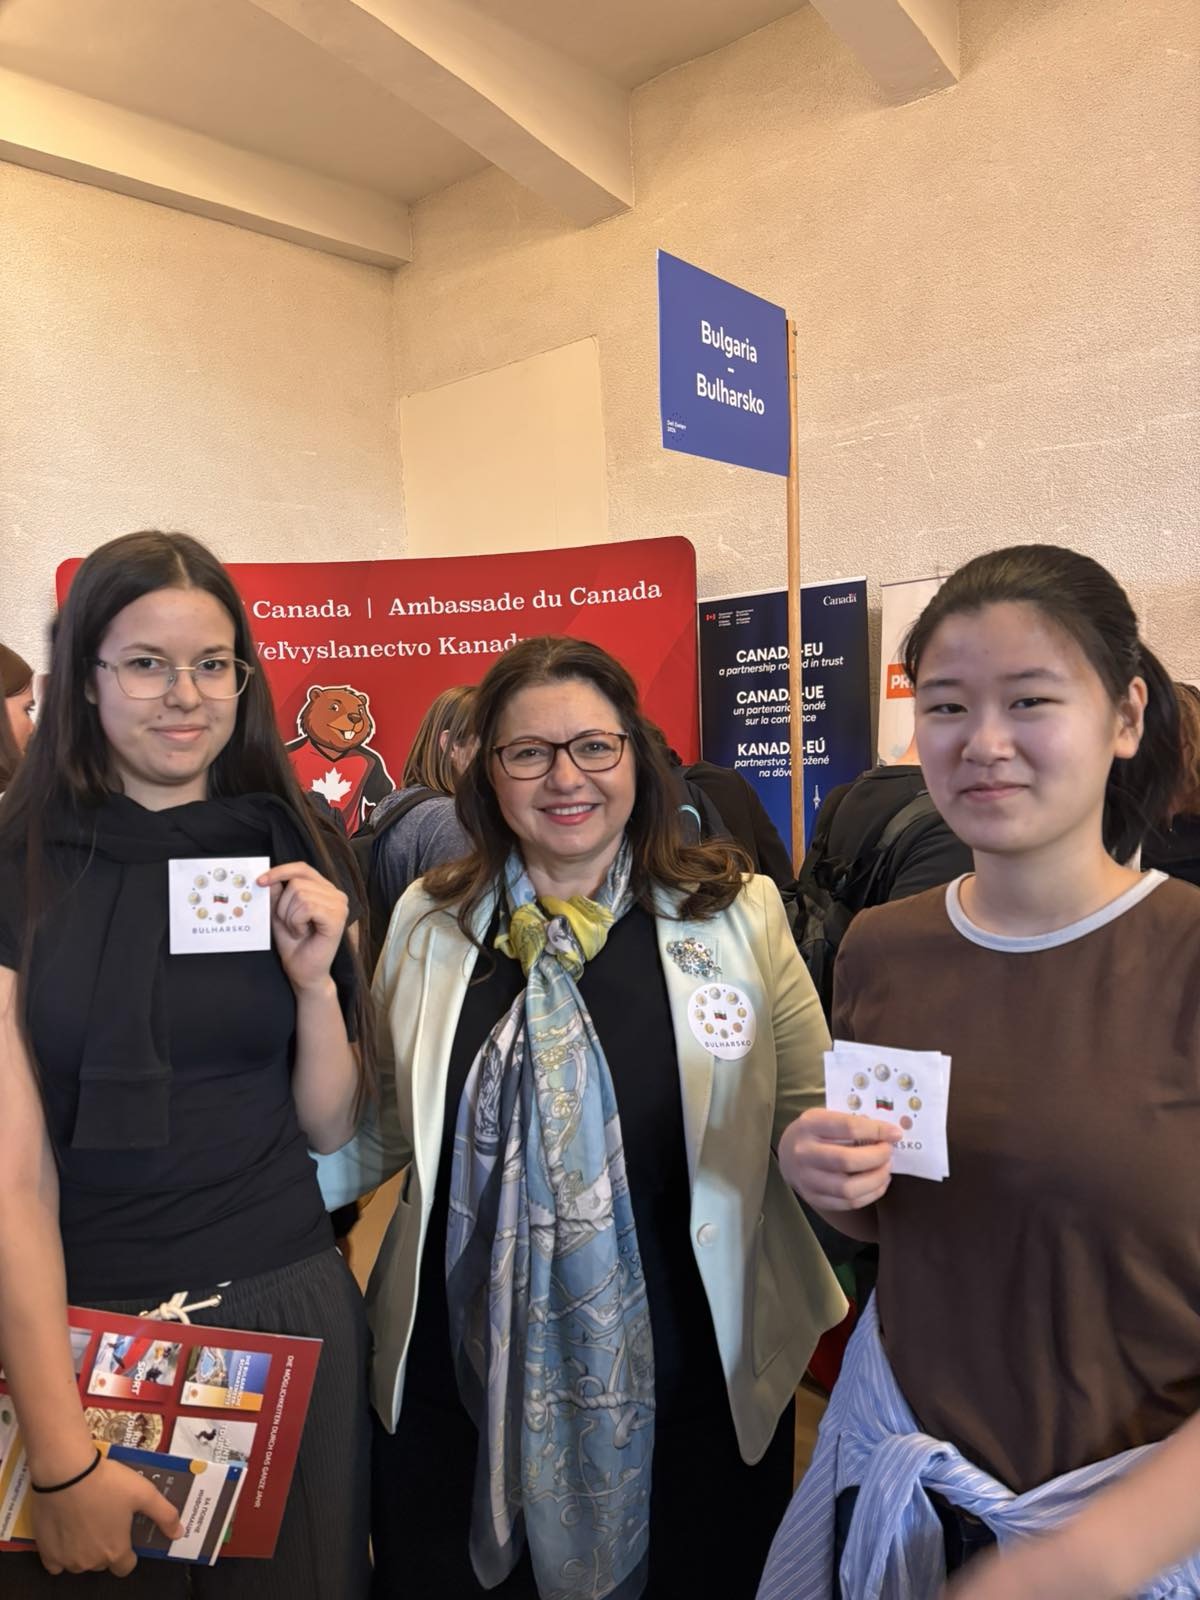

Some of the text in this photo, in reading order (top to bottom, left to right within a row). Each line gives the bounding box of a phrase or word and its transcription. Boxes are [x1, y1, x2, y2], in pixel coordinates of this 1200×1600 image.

[701, 320, 757, 363] Bulgaria
[697, 373, 765, 415] Bulharsko
[252, 600, 351, 619] Canada
[388, 592, 525, 616] Ambassade
[532, 590, 563, 609] du
[569, 580, 662, 606] Canada
[823, 593, 857, 606] Canada
[439, 633, 522, 655] Kanad
[736, 642, 823, 663] CANAD-EU
[718, 668, 725, 676] a
[726, 662, 776, 677] partnership
[810, 658, 819, 668] in
[821, 656, 844, 667] trust
[891, 674, 913, 690] PR
[736, 685, 824, 704] CANAD-UE
[733, 707, 745, 716] un
[801, 700, 827, 711] ondé
[745, 717, 758, 726] sur
[760, 716, 769, 725] la
[737, 737, 826, 756] KANAD-EÚ
[734, 758, 787, 769] partnerstvo
[759, 769, 770, 778] na
[192, 925, 250, 934] BULHARSKO
[705, 1040, 751, 1048] BULHARSKO
[131, 1361, 146, 1396] SPORT
[267, 1426, 279, 1450] DURCH
[264, 1451, 273, 1466] DAS
[183, 1489, 204, 1538] ИНФОРМАЦИЯ
